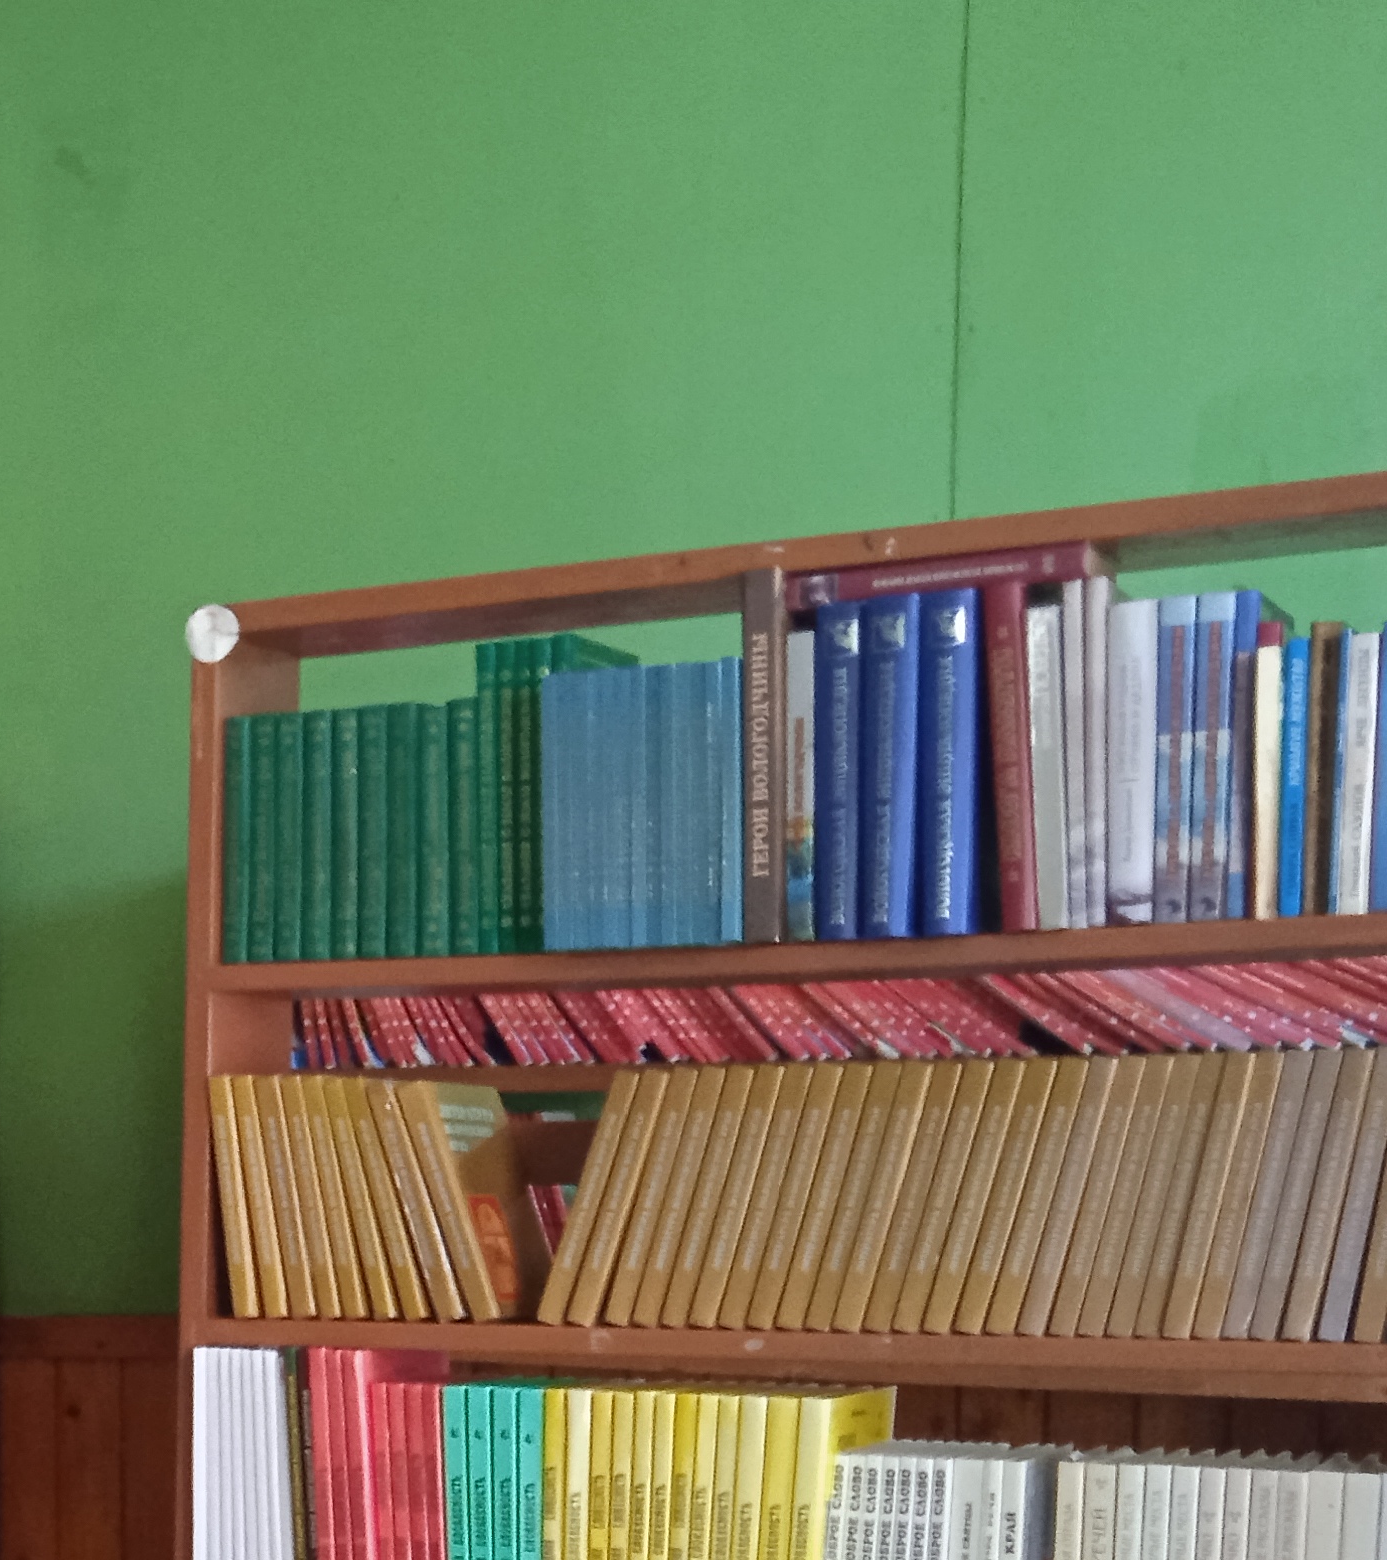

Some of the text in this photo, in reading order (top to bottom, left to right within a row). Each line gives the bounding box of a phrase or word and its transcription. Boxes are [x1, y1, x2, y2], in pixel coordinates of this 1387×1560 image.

[751, 632, 771, 877] ГЕРОИ ВОЛОГОДЧИНЫ
[831, 1465, 844, 1510] СЛОВО
[849, 1466, 862, 1512] СЛОВО
[865, 1468, 878, 1513] СЛОВО
[883, 1469, 895, 1515] СЛОВО
[899, 1469, 911, 1515] СЛОВО
[916, 1471, 928, 1517] СЛОВО
[933, 1470, 946, 1516] СЛОВО
[1004, 1512, 1016, 1554] КРАЙ
